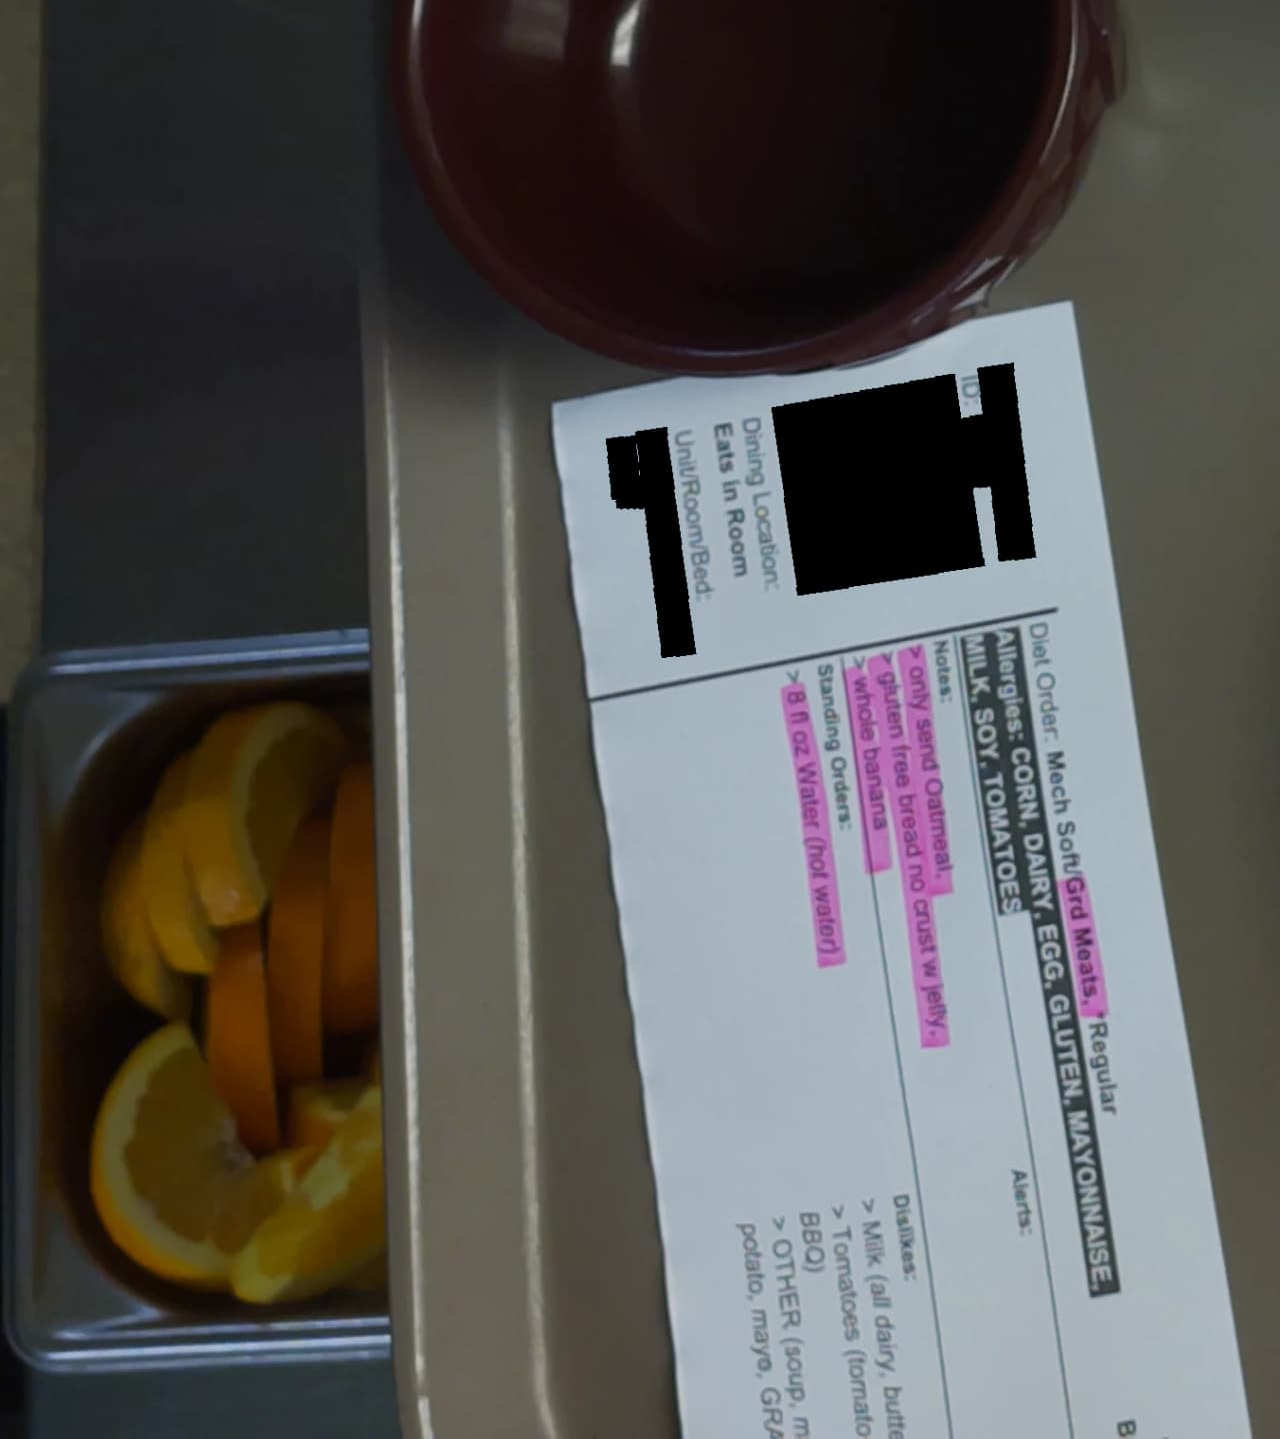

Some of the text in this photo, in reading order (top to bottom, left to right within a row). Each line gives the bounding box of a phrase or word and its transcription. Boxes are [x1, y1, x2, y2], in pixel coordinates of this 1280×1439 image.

[961, 375, 980, 405] ID:
[674, 429, 714, 602] Unit/Room/Bed:
[714, 422, 752, 576] Eats in Room
[738, 417, 782, 591] Dining Location:
[933, 640, 954, 702] Notes:
[1028, 623, 1051, 666] Diet
[787, 690, 805, 704] 8
[790, 711, 808, 724] fl
[853, 677, 876, 741] whole
[878, 671, 905, 738] gluten
[906, 666, 929, 710] only
[1035, 672, 1062, 741] Order:
[792, 731, 809, 755] oz
[815, 664, 853, 830] Standing Orders:
[891, 745, 912, 787] free
[916, 718, 938, 770] send
[964, 635, 1022, 915] MILK, SOY, TOMATOES
[797, 763, 823, 828] Water
[863, 748, 889, 830] banana
[1046, 751, 1072, 813] Mech
[898, 794, 920, 842] bread
[803, 835, 829, 879] (hot
[909, 864, 924, 891] no
[1057, 820, 1087, 919] Soft/Grd
[812, 885, 838, 955] water)
[913, 898, 935, 953] crust
[922, 961, 935, 978] w
[993, 629, 1114, 1292] Allergies: CORN, DAIRY, EGG, GLUTEN, MAYONNAISE,
[1072, 928, 1100, 1006] Meats,
[1010, 1169, 1034, 1236] Alerts:
[736, 1223, 765, 1301] potato,
[800, 1212, 825, 1273] BBQ)
[863, 1220, 885, 1268] Milk
[893, 1194, 917, 1281] Dislikes:
[772, 1239, 801, 1329] OTHER
[832, 1226, 860, 1341] Tomatoes
[864, 1274, 892, 1308] (all
[750, 1310, 772, 1379] mayo,
[780, 1337, 806, 1408] (soup,
[874, 1315, 895, 1378] dairy,
